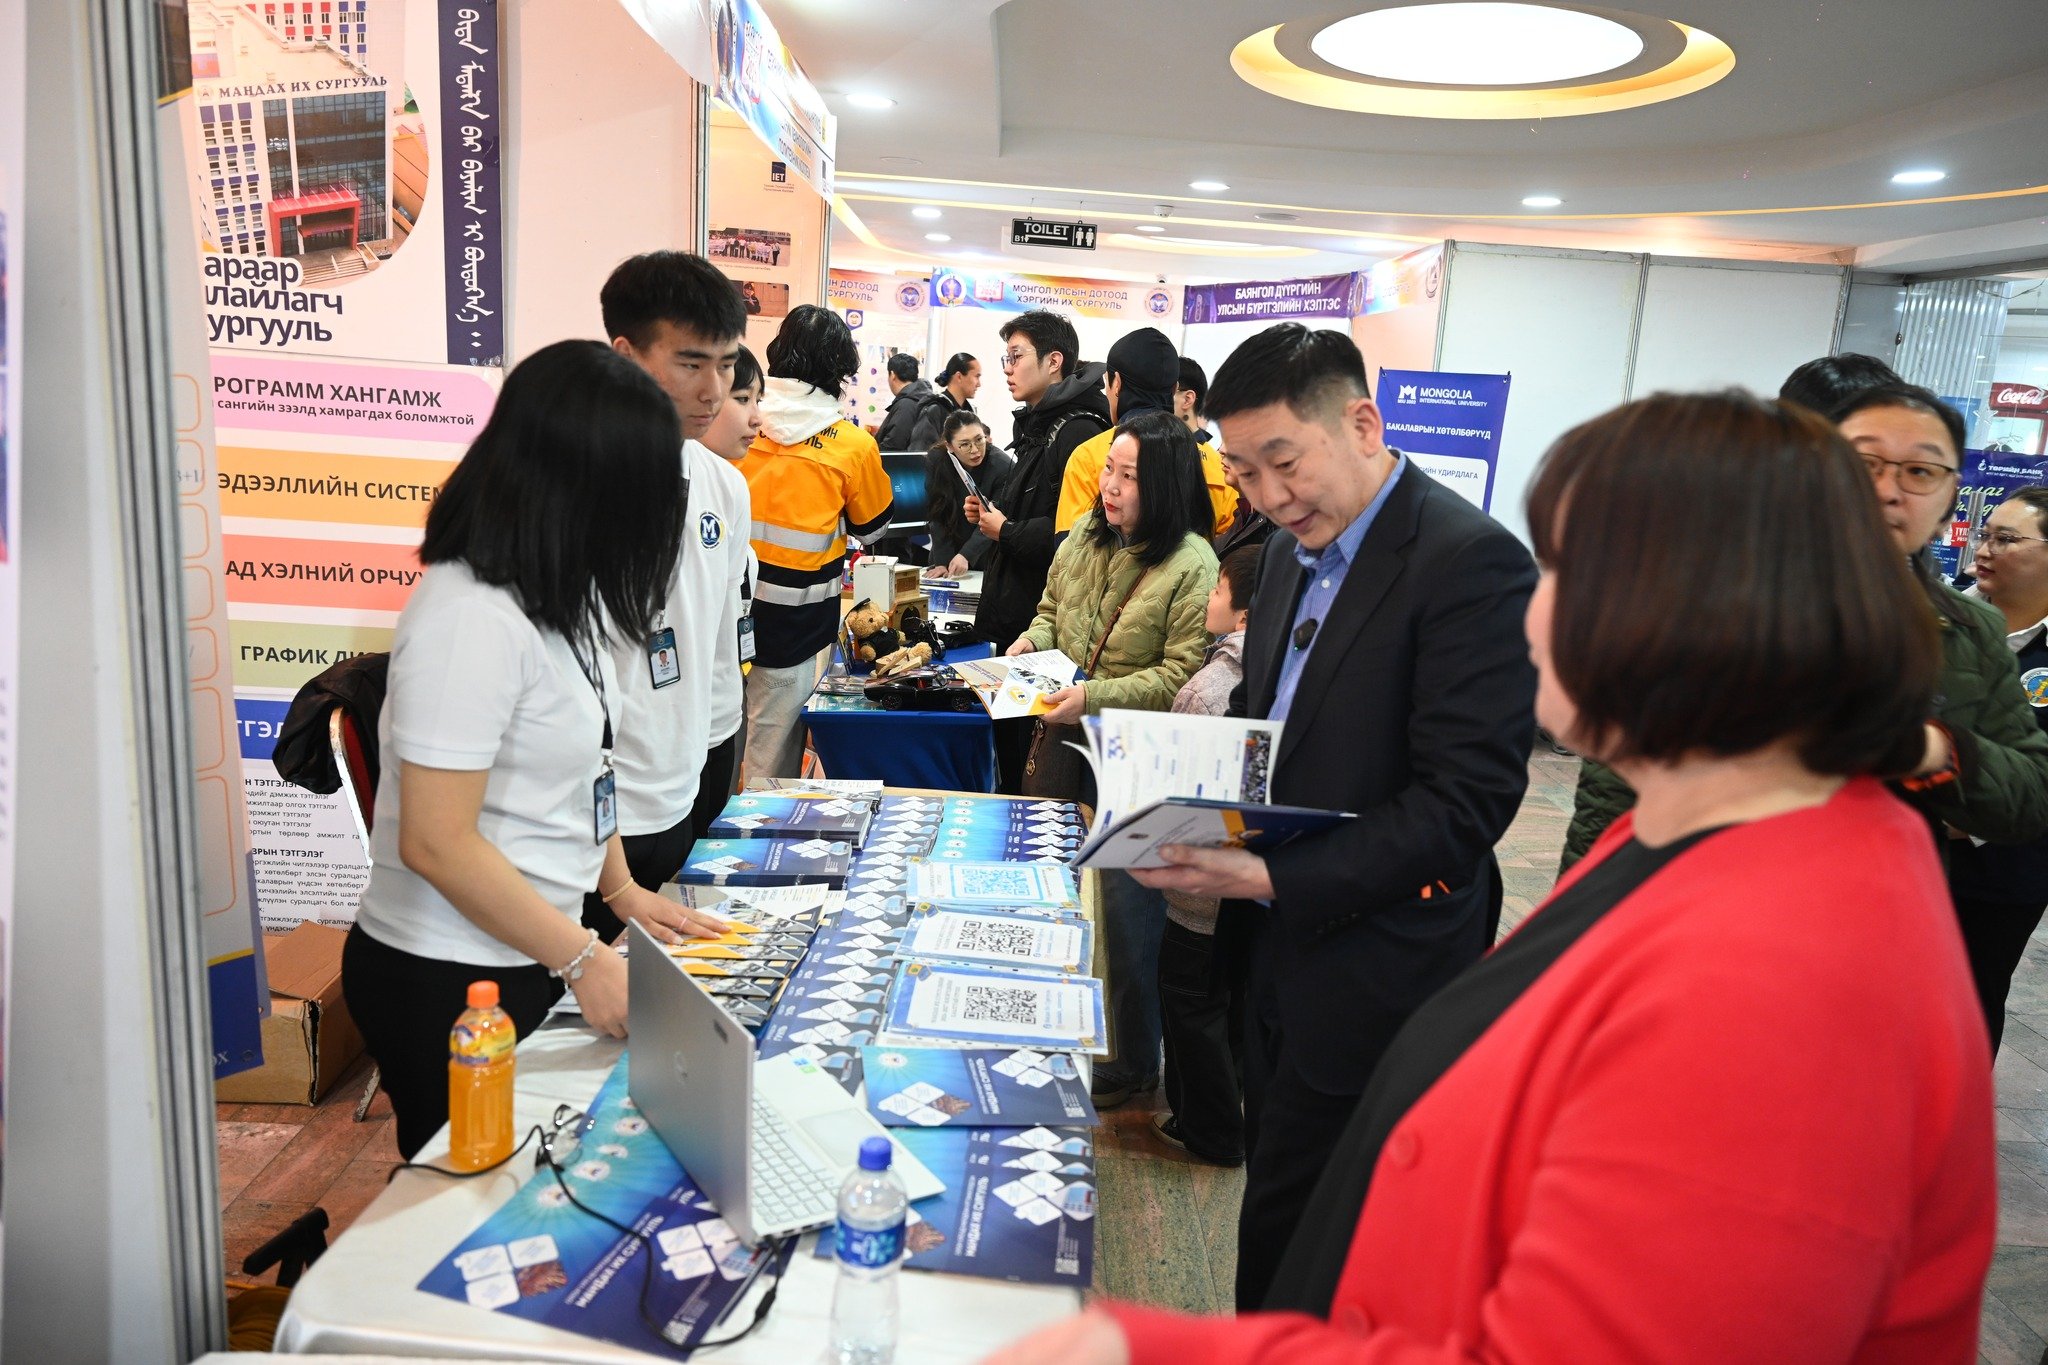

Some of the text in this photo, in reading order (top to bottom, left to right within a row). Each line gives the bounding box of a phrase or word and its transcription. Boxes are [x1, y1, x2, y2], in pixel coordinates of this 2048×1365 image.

[219, 77, 387, 98] МАНДАХ ИХ СУРГУУЛЬ
[1024, 223, 1069, 236] TOILET
[204, 256, 299, 290] араар
[840, 280, 879, 292] ДОТООД
[1013, 284, 1128, 300] МОНГОЛ УЛСЫН ДОТООД
[1235, 280, 1322, 300] БАЯНГОЛ ДҮҮРГИЙН
[828, 289, 873, 301] СУРГУУЛЬ
[1017, 295, 1122, 310] ХЭРГИЙН ИХ СУРГУУЛЬ
[1217, 303, 1246, 316] УЛСЫН
[1303, 297, 1341, 312] ХЭЛТЭС
[207, 314, 333, 346] ургууль
[214, 376, 442, 408] РОГРАММ ХАНГАМЖ
[1420, 387, 1473, 399] MONGOLIA
[217, 399, 474, 425] сангийн зээлд хамрагдах боломжтой
[1386, 422, 1491, 440] БАКАЛАВРЫН ХӨТӨЛБӨРҮҮД
[1437, 469, 1478, 479] УДИРДЛАГА
[218, 473, 358, 497] ЭДЭЭЛЛИЙН
[225, 560, 257, 581] АД
[261, 562, 354, 583] ХЭЛНИЙ
[241, 645, 329, 664] ГРАФИК
[253, 820, 280, 828] оюутан
[280, 849, 324, 858] ТЭТГЭЛЭГ
[292, 861, 330, 869] чиглэлээр
[264, 869, 302, 877] хөтөлбөрт
[330, 872, 368, 880] суралцагч
[326, 881, 364, 889] хөтөлбөрт
[290, 898, 327, 906] суралцагч
